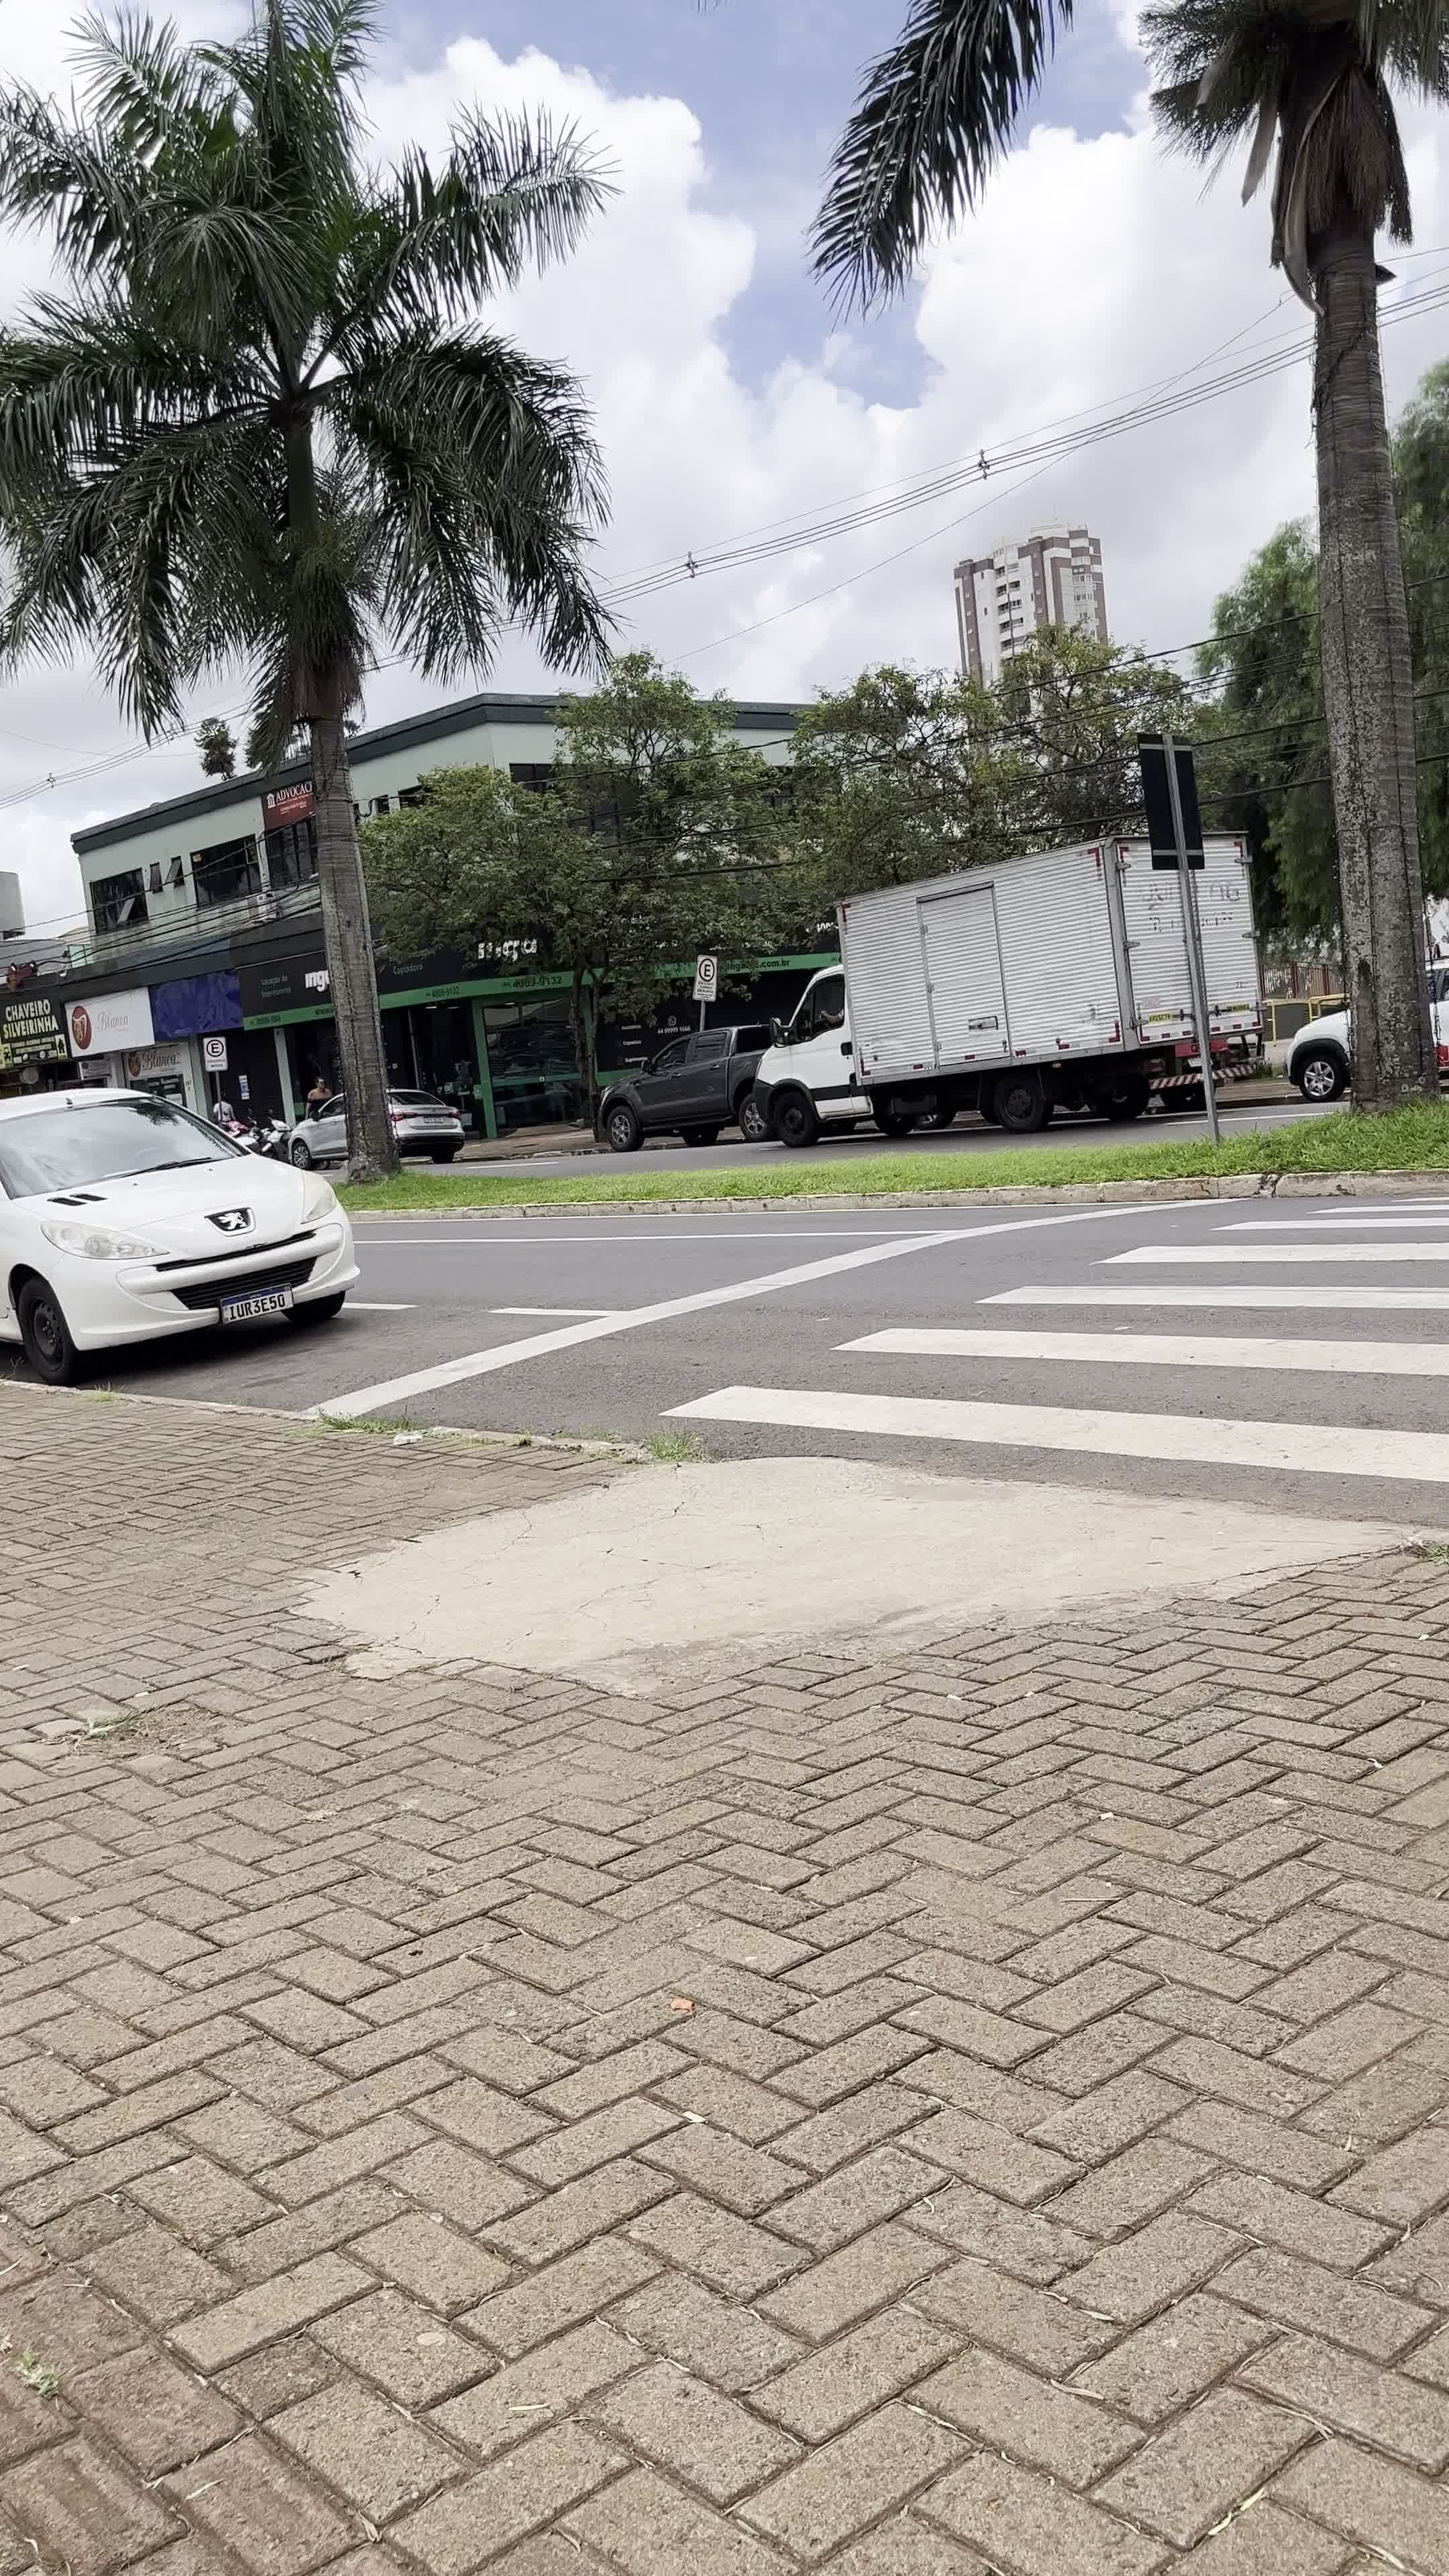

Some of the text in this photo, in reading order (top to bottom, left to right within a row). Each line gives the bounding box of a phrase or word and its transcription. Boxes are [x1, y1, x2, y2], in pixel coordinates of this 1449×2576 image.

[704, 964, 711, 977] E
[5, 999, 51, 1022] CHAVEIRO
[3, 1015, 59, 1039] SILVEIRINHA
[211, 1043, 220, 1053] E
[229, 1293, 286, 1321] IUR3E50
